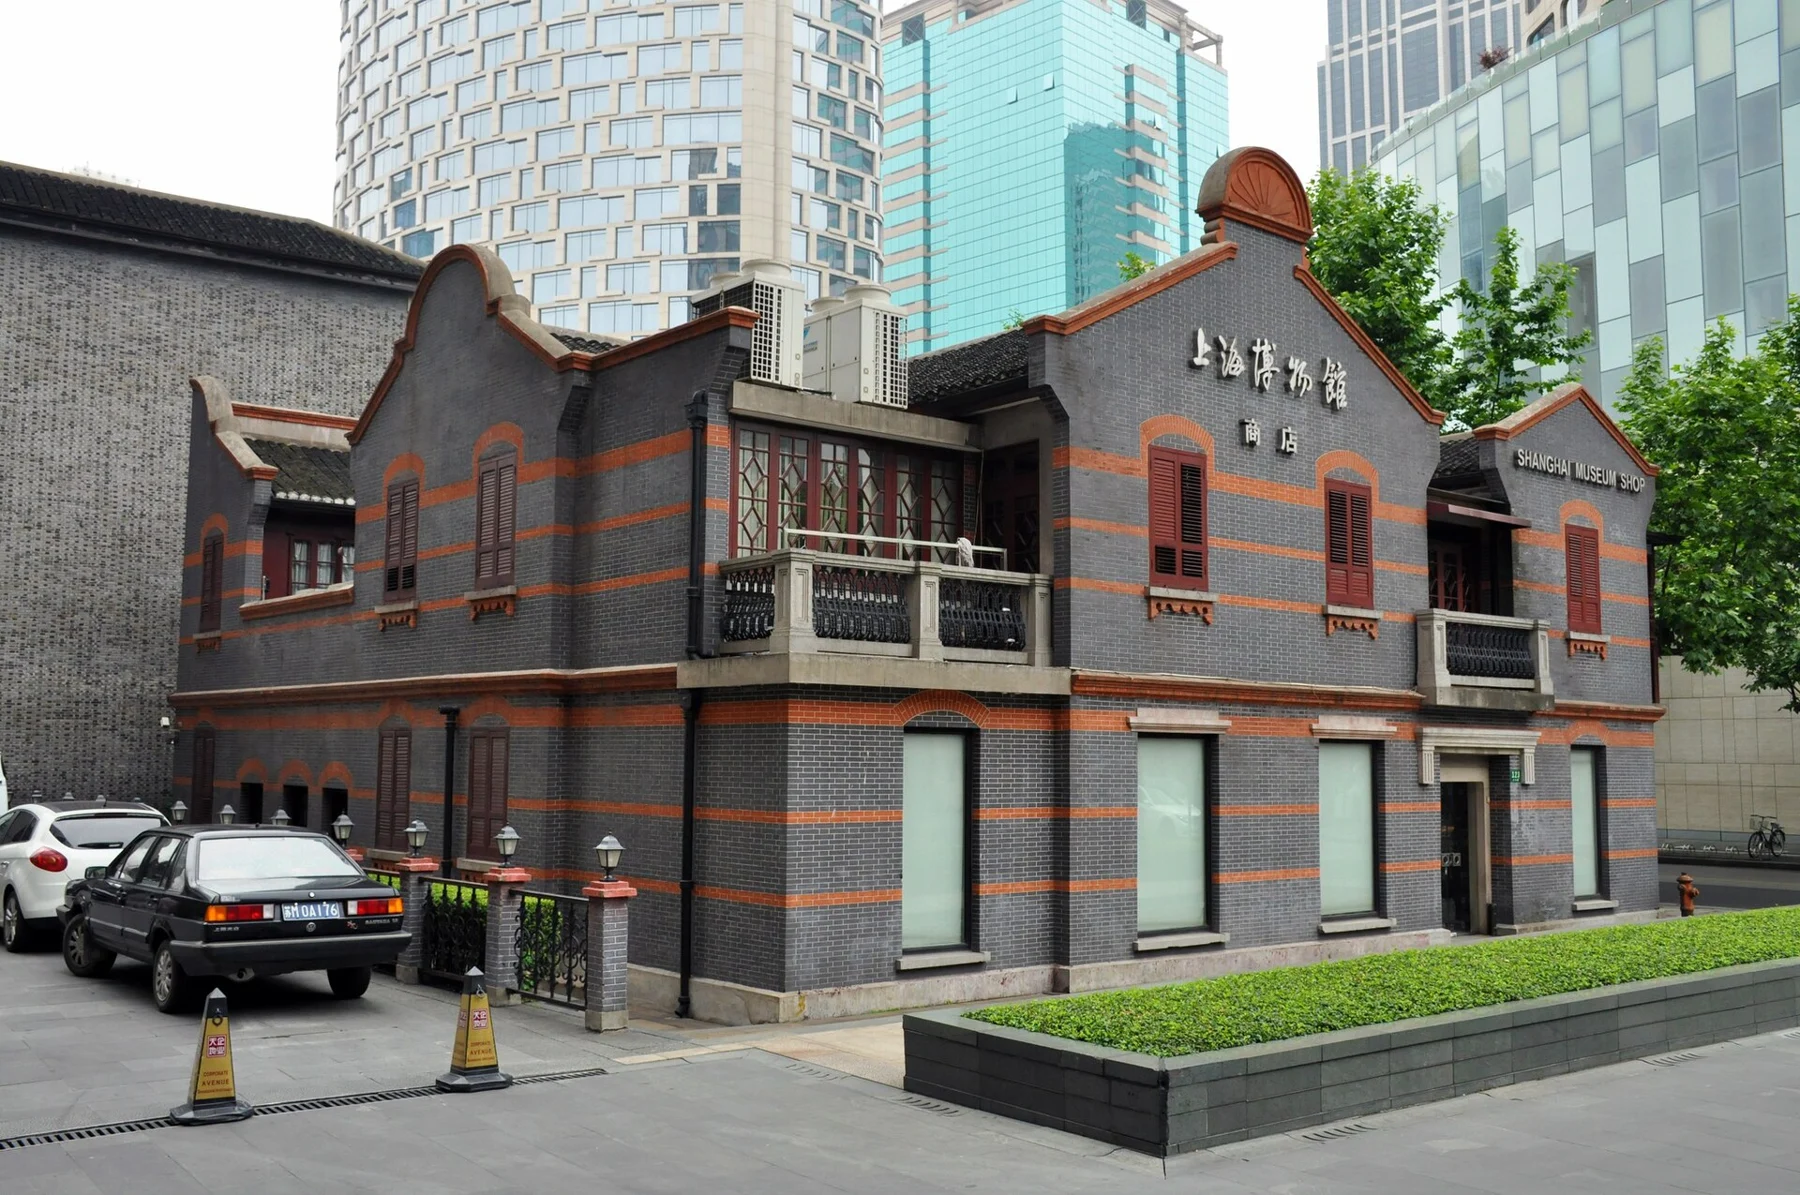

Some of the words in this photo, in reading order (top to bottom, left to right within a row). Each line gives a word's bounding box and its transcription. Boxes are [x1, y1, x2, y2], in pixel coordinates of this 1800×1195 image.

[1244, 419, 1297, 453] 商店
[1517, 449, 1571, 476] SHANGHAI
[1575, 463, 1617, 486] MUSEUM
[1620, 472, 1646, 493] SHOP
[202, 1079, 230, 1087] AVENUE
